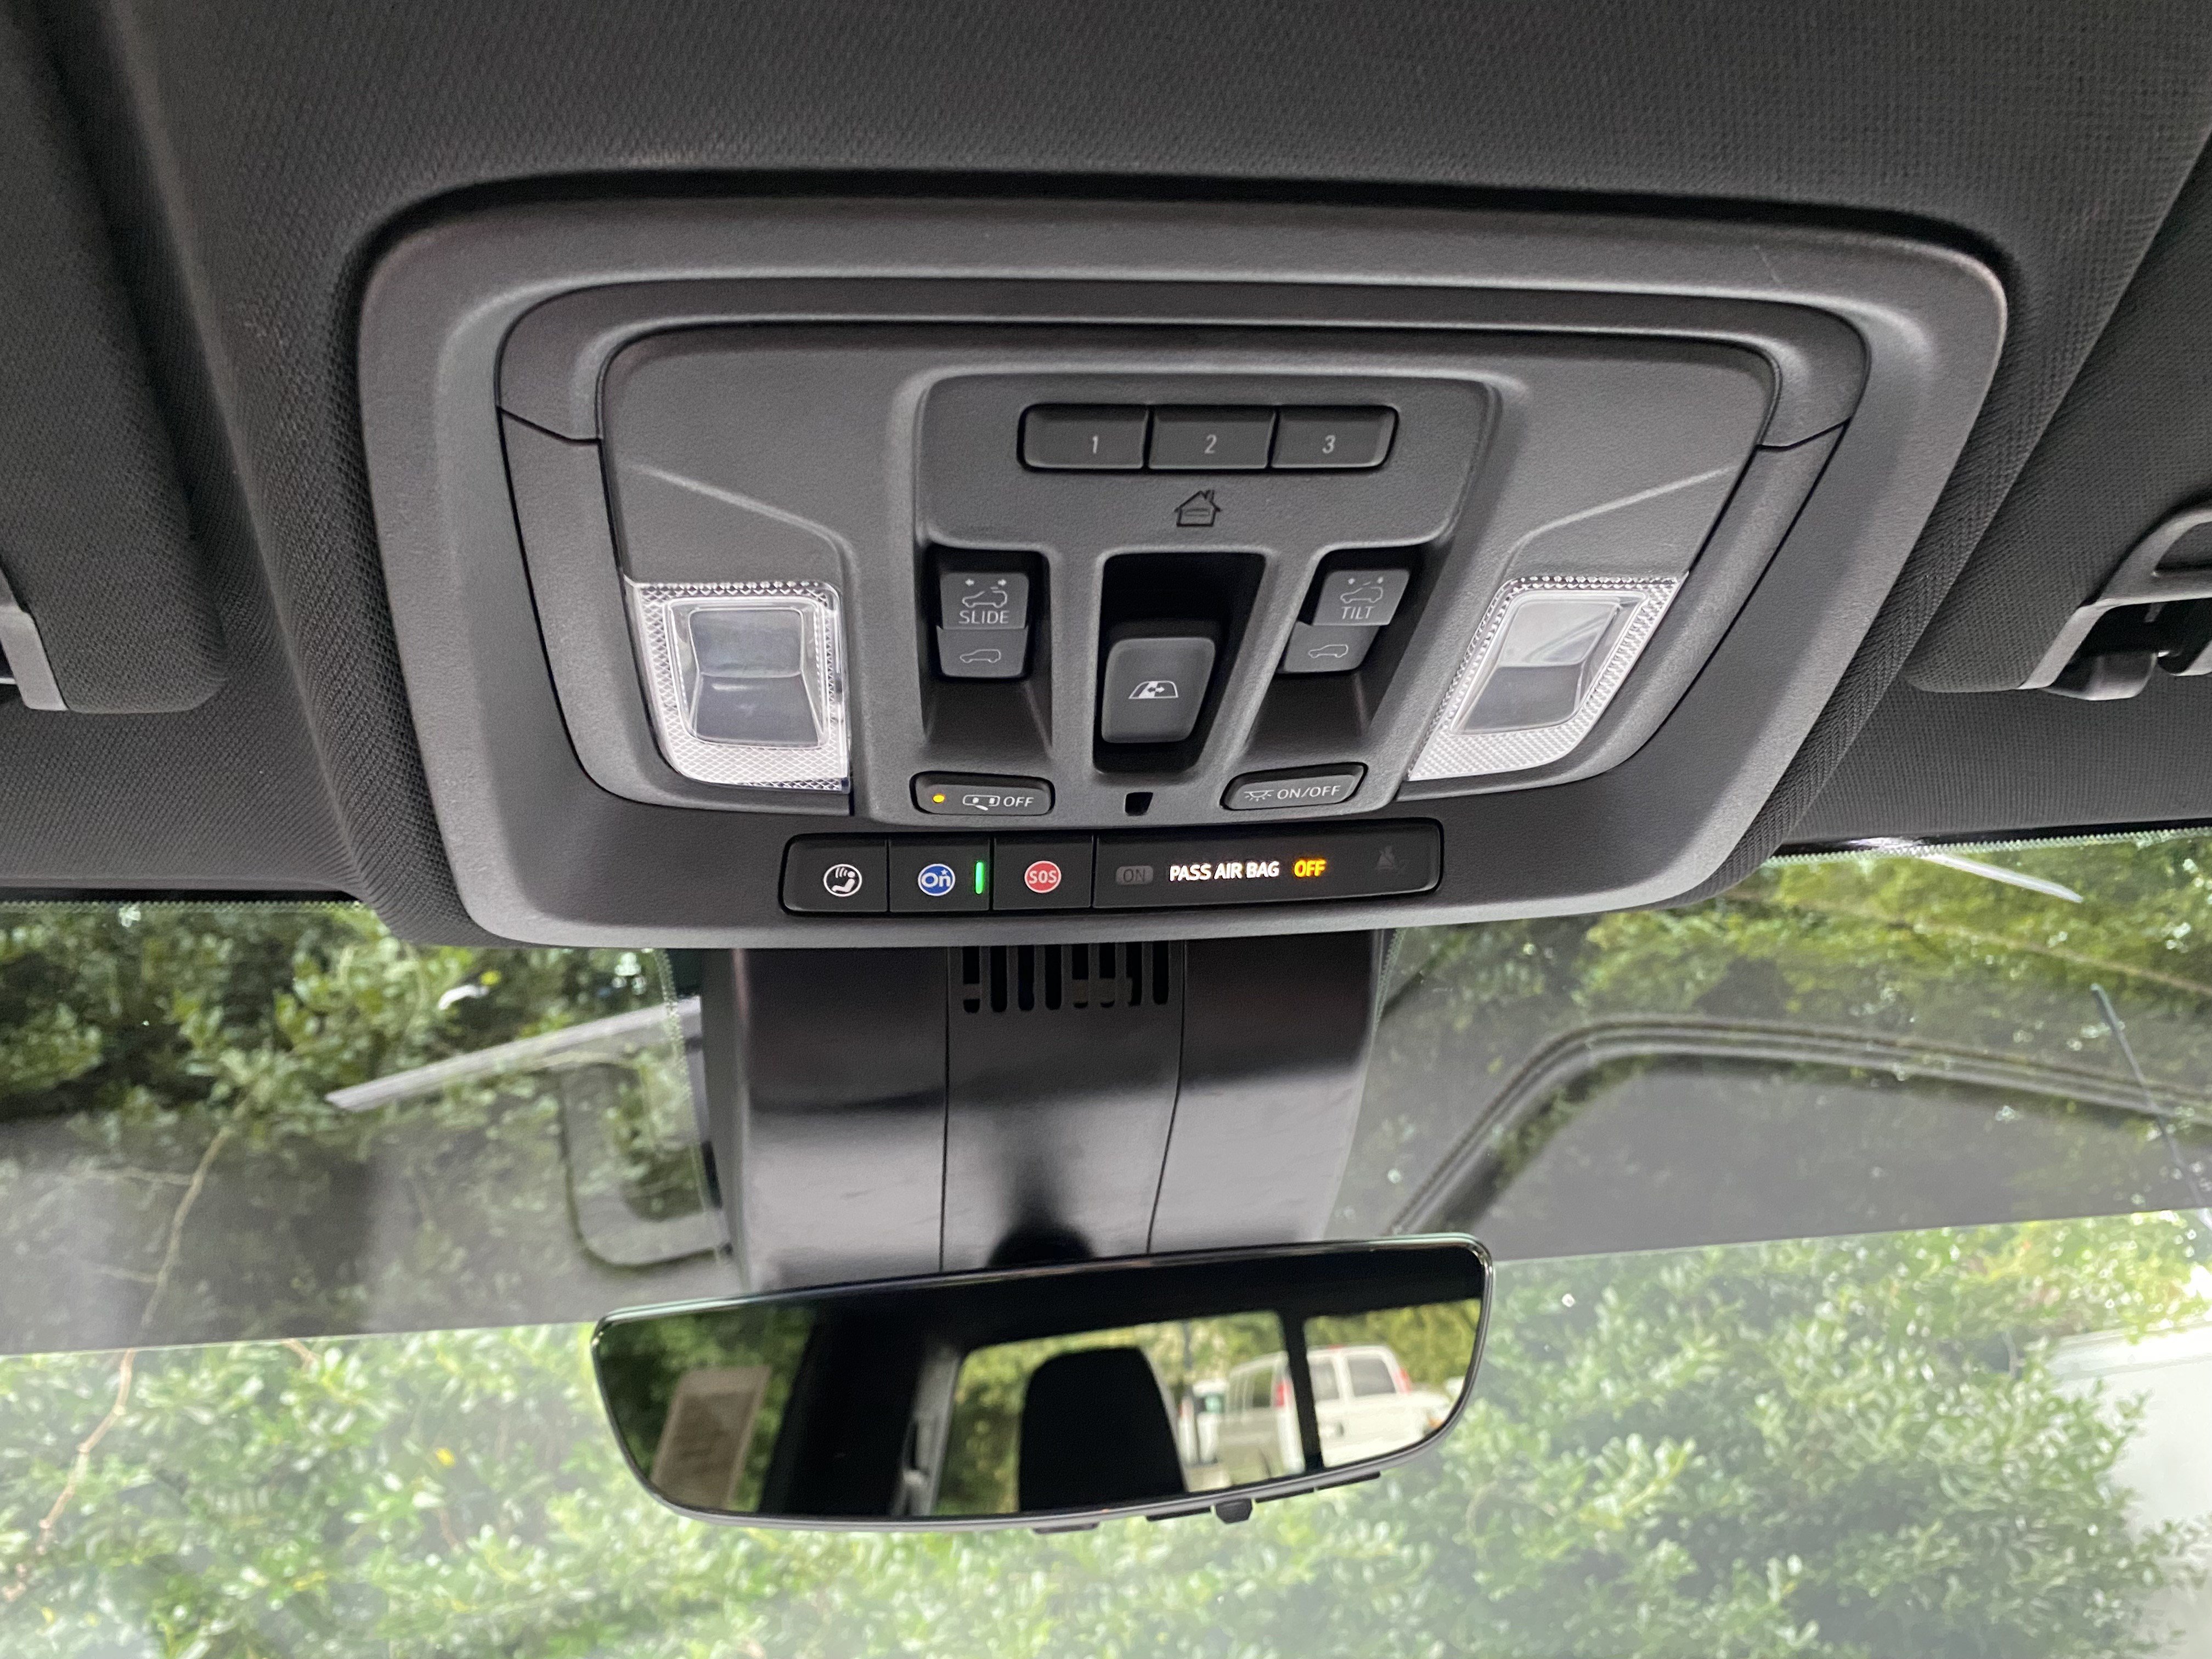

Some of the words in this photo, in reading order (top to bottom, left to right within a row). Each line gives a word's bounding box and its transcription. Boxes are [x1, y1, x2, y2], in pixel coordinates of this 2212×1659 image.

[1092, 436, 1098, 454] 1
[1204, 435, 1217, 454] 2
[1322, 435, 1336, 454] 3
[958, 610, 1011, 624] SLIDE
[1341, 606, 1376, 620] TILT
[1277, 785, 1341, 800] ON/OFF
[1003, 796, 1035, 808] OFF
[1028, 870, 1058, 884] SOS
[1122, 869, 1146, 883] ON
[1169, 863, 1212, 881] PASS
[1214, 862, 1243, 880] AIR
[1246, 861, 1280, 879] BAG
[1293, 859, 1326, 877] OFF
